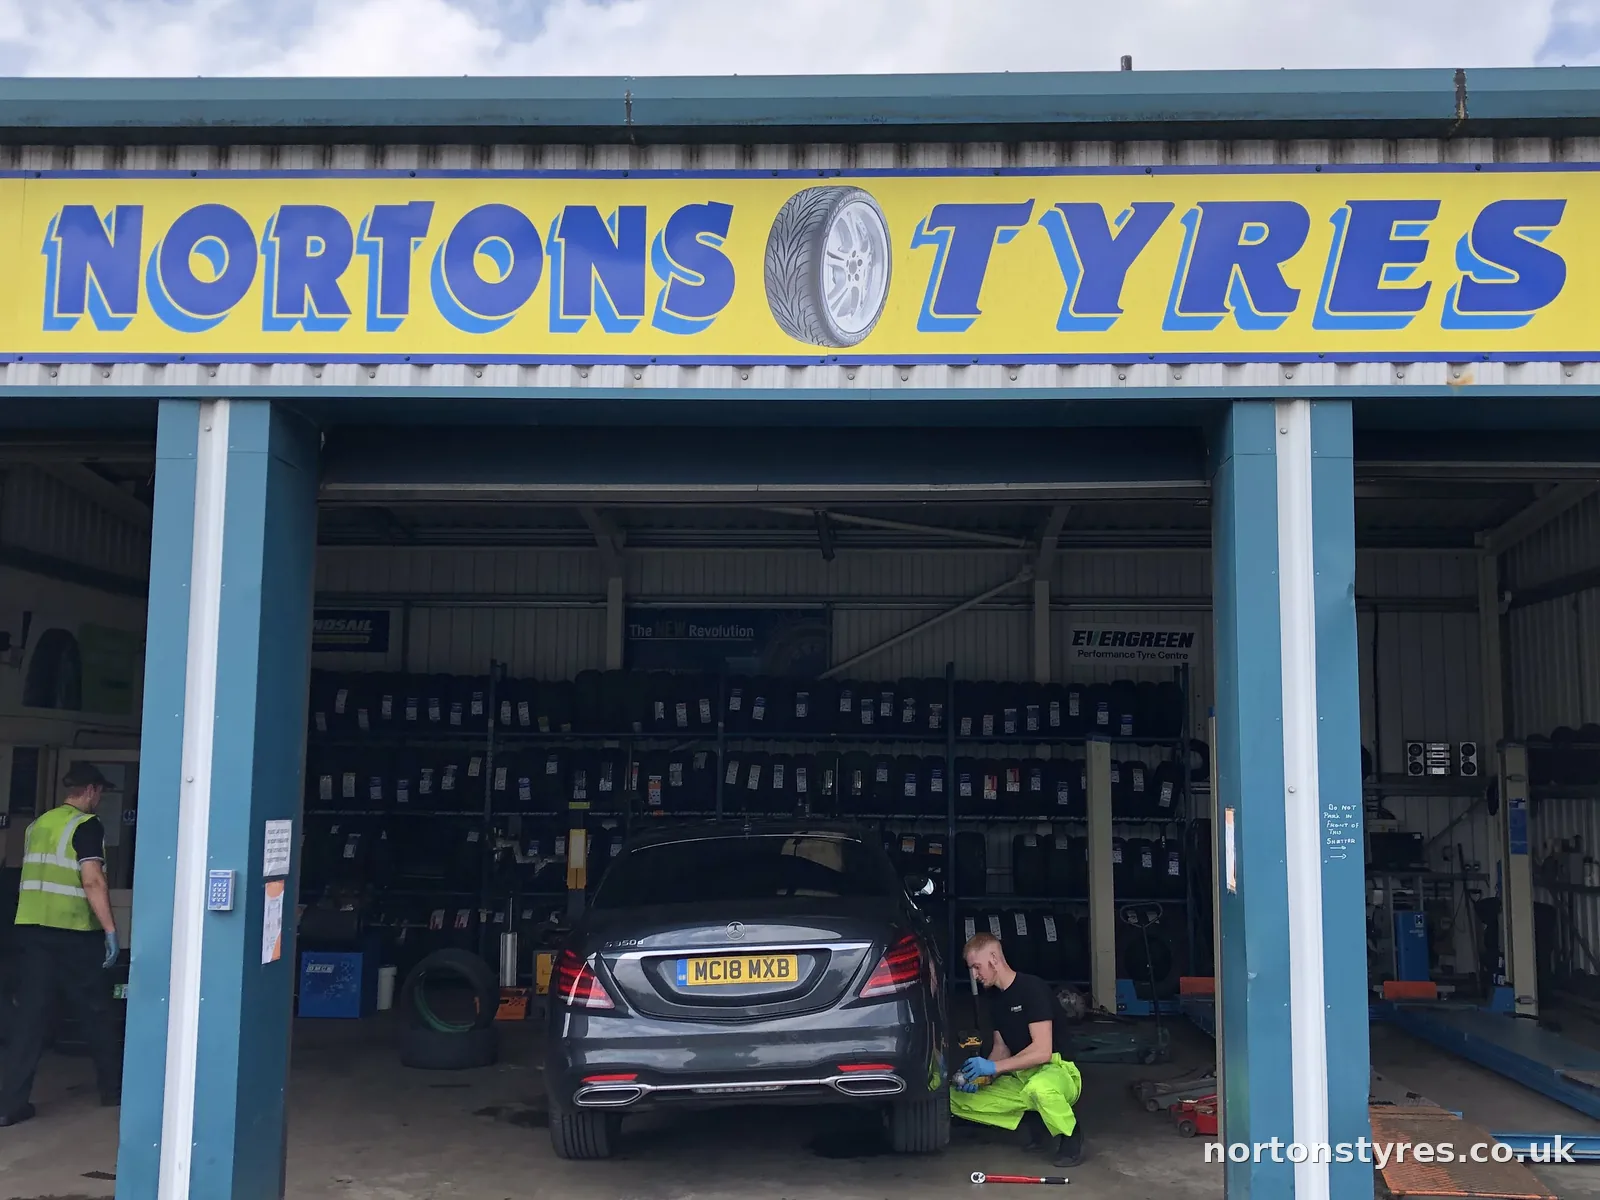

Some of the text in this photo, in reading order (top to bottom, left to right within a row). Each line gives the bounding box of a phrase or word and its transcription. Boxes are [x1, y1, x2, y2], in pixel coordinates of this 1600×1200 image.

[41, 198, 1567, 335] NORTONS TYRES
[629, 620, 754, 637] The NEW Revolution
[1071, 630, 1195, 648] EVERGREEN
[1077, 650, 1188, 661] Performance Tyre Centre
[694, 958, 790, 981] MC18 MXB
